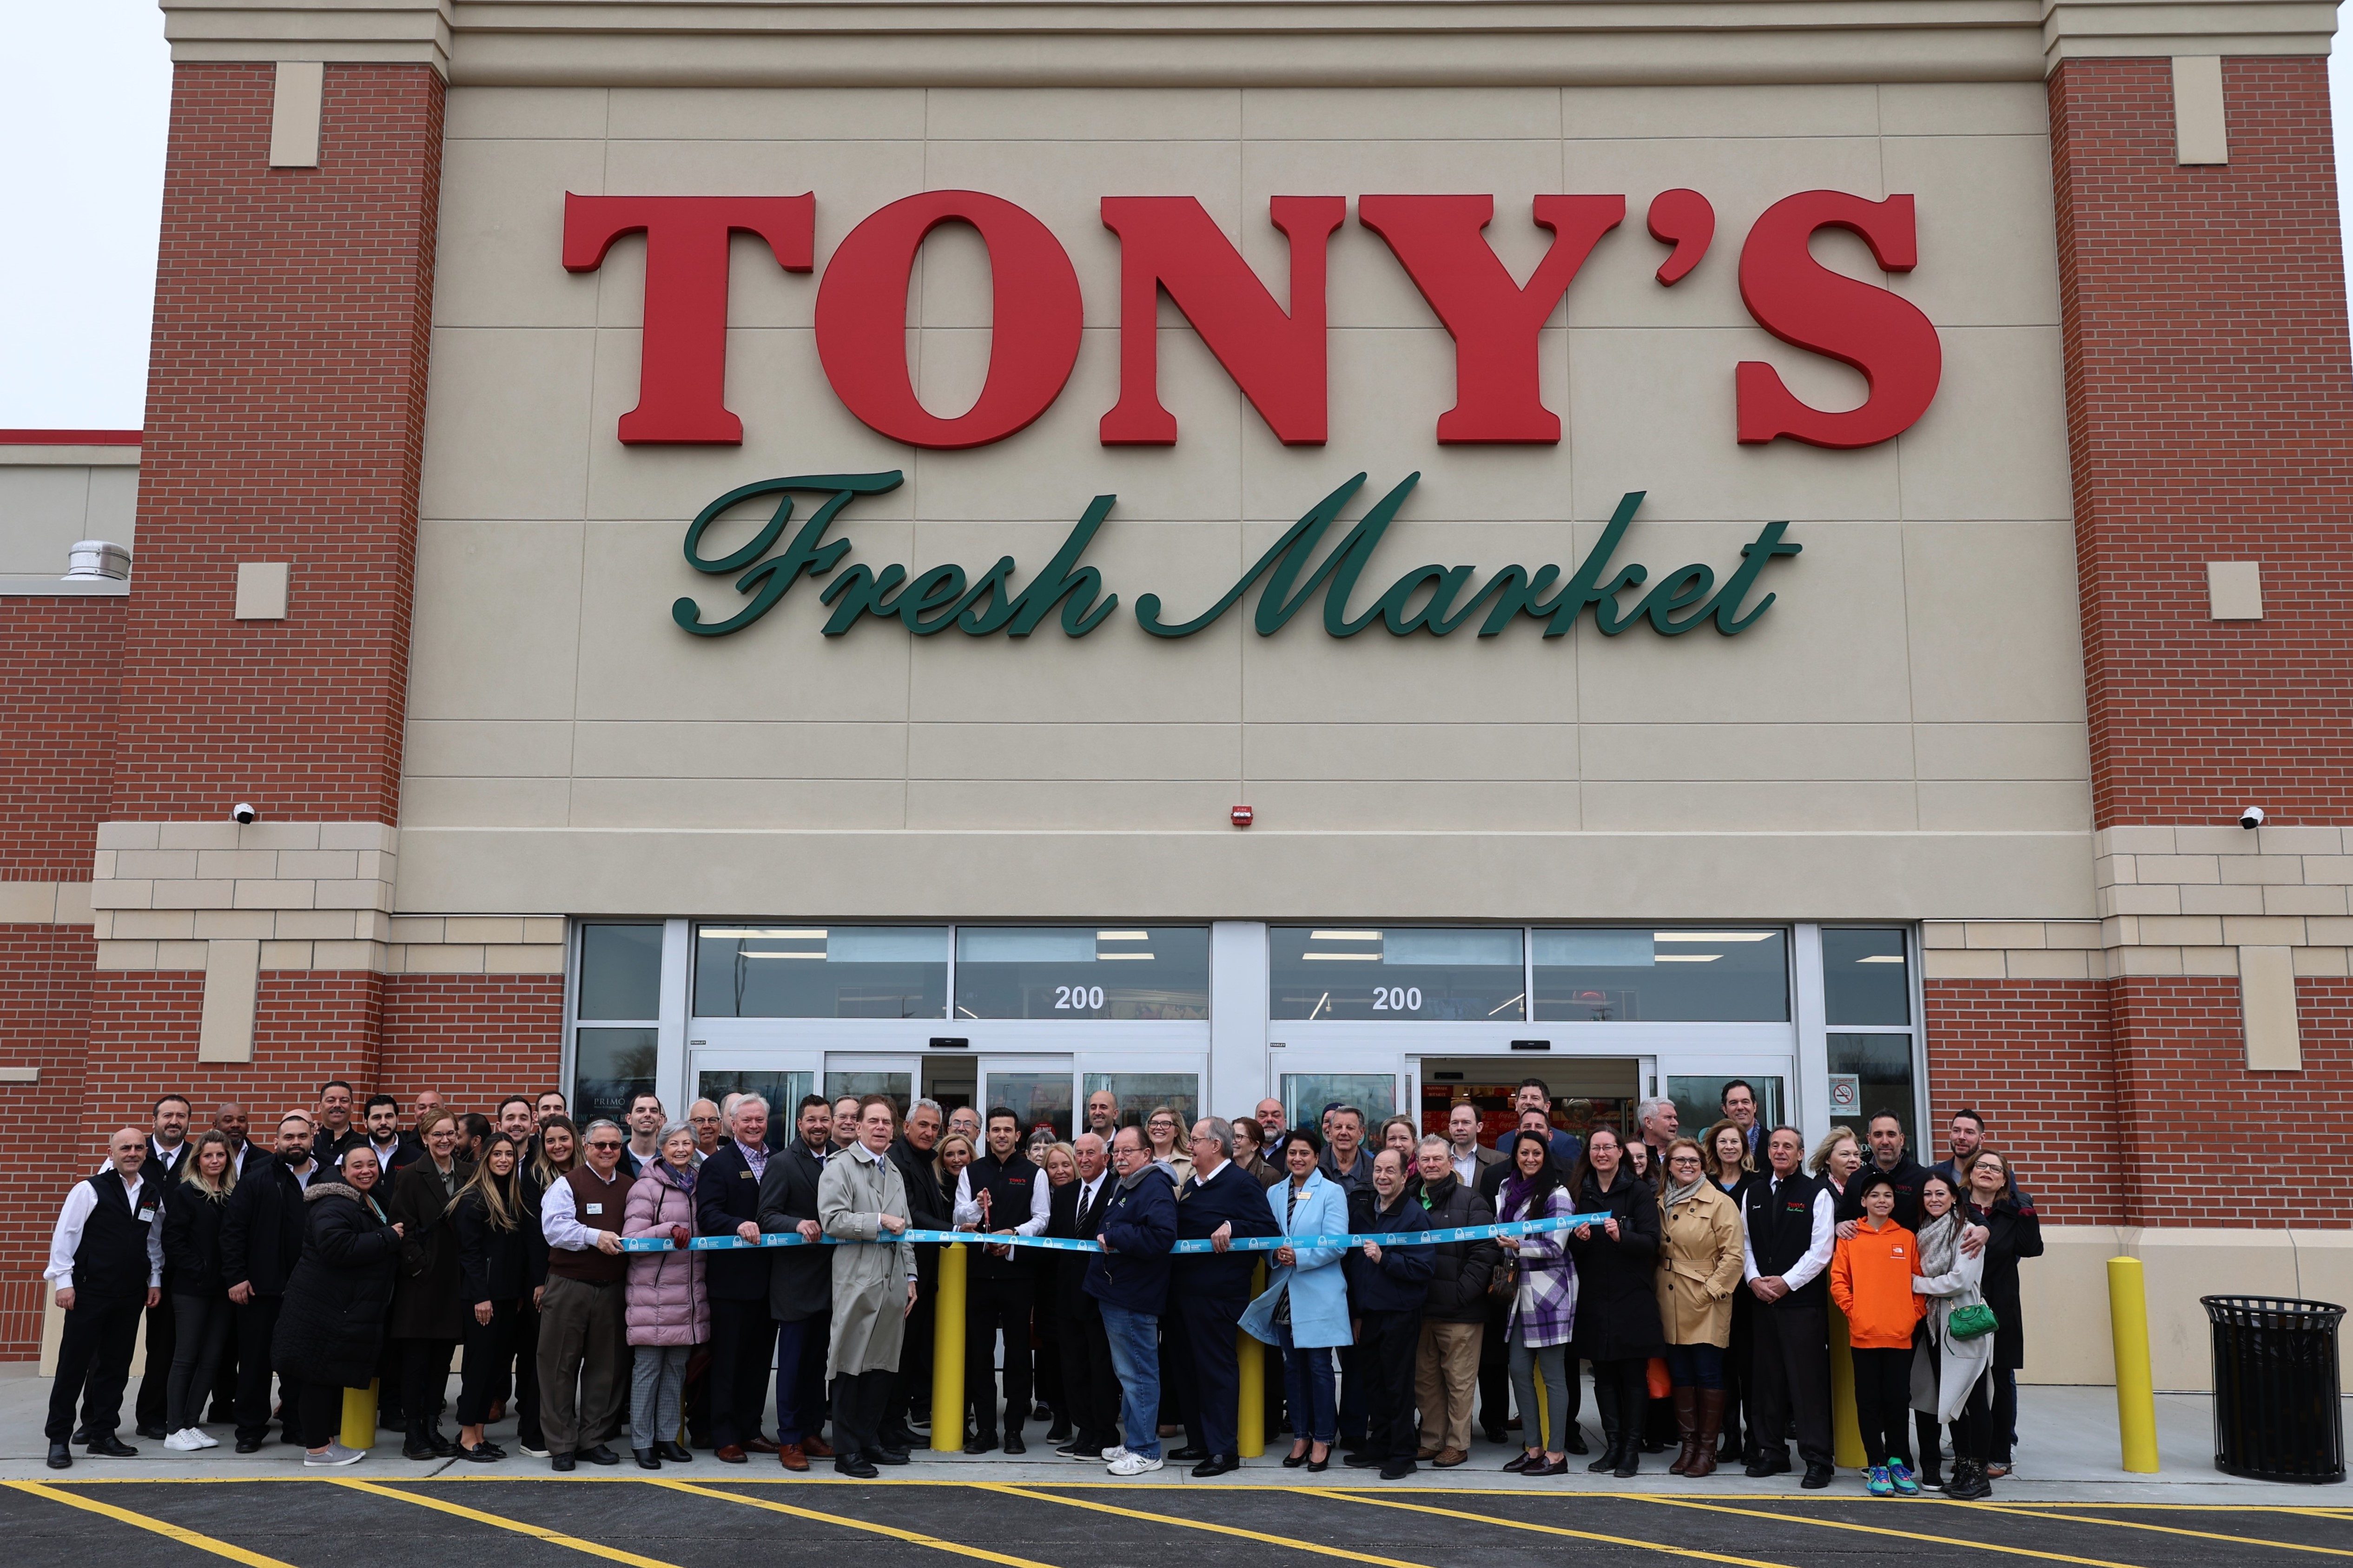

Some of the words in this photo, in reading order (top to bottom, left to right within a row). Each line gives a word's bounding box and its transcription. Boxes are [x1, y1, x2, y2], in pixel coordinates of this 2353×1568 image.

[562, 190, 1942, 447] TONY'S
[672, 471, 1118, 636] Fresh
[1135, 471, 1803, 637] Market
[1055, 986, 1104, 1009] 200
[1373, 987, 1422, 1010] 200
